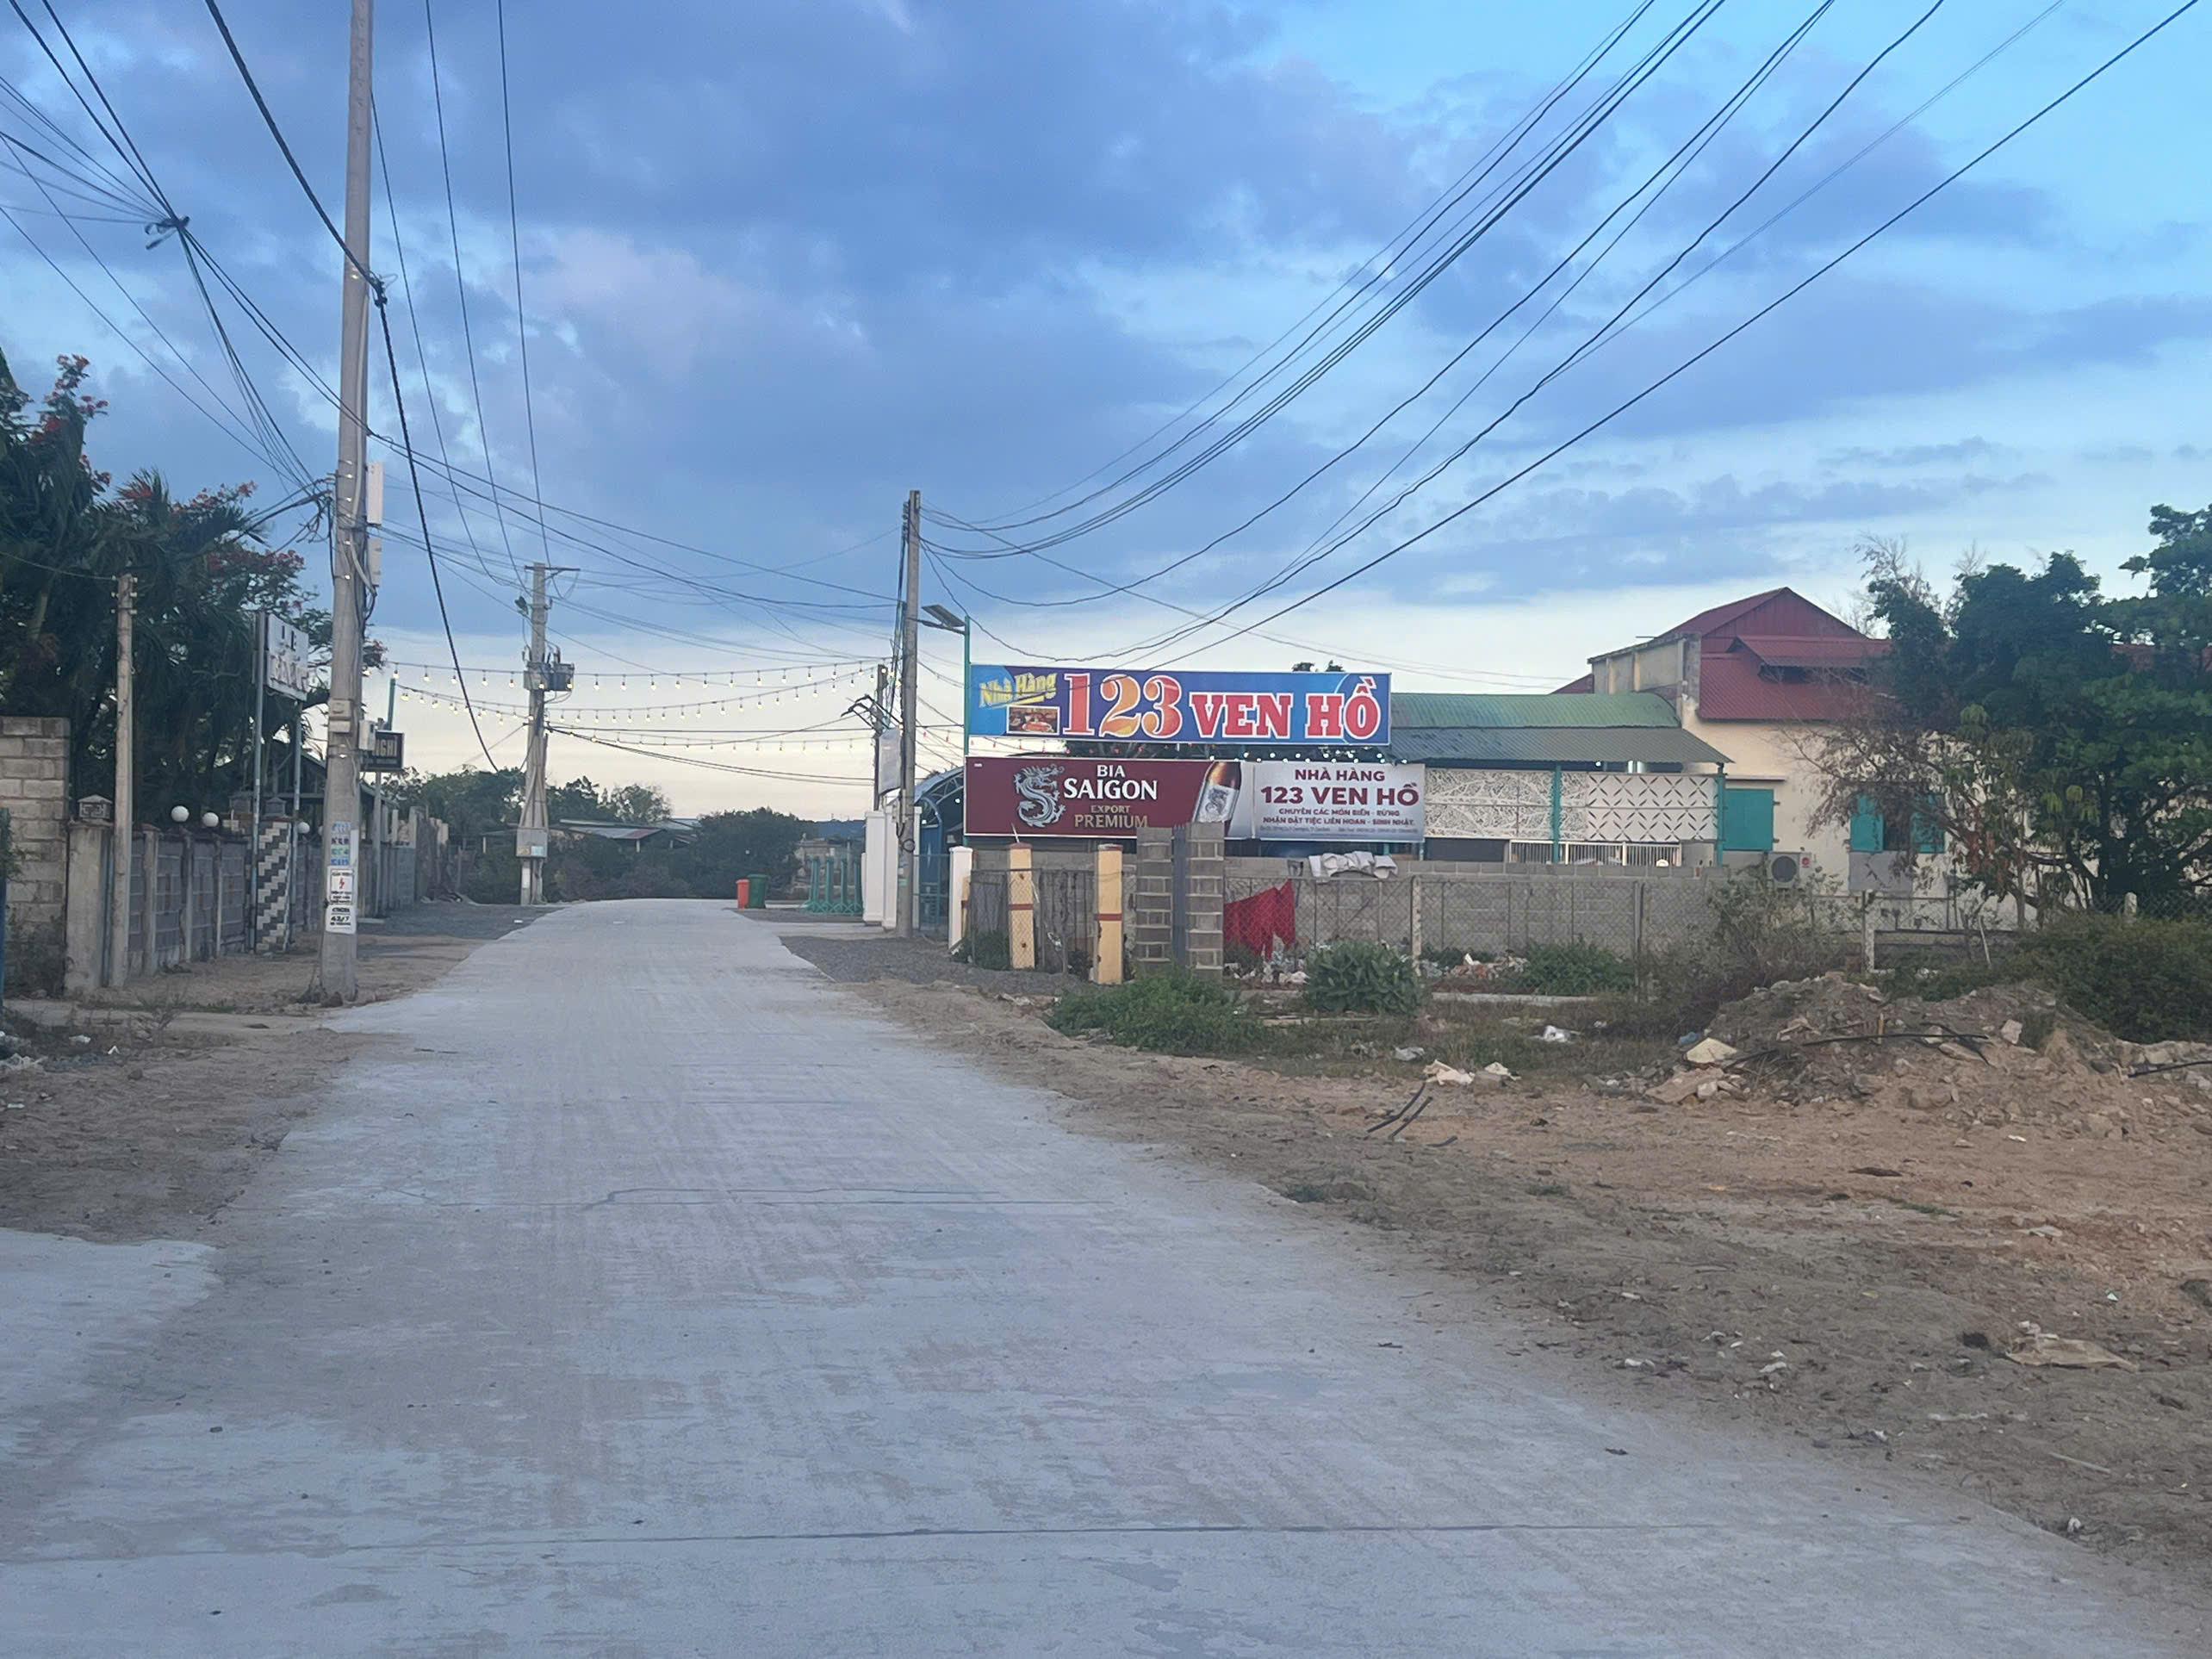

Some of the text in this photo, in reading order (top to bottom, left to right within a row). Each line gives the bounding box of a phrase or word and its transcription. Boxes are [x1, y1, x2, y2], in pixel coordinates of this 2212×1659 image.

[1014, 673, 1058, 699] Hàng
[1063, 673, 1381, 740] 123 VEN HỒ
[1097, 765, 1126, 778] BIA
[1295, 767, 1385, 781] NHÀ HÀNG
[1063, 778, 1158, 800] SAIGON
[1261, 782, 1420, 806] 123 VEN HỒ
[1090, 805, 1131, 814] EXPORT
[1074, 814, 1148, 828] PREMIUM
